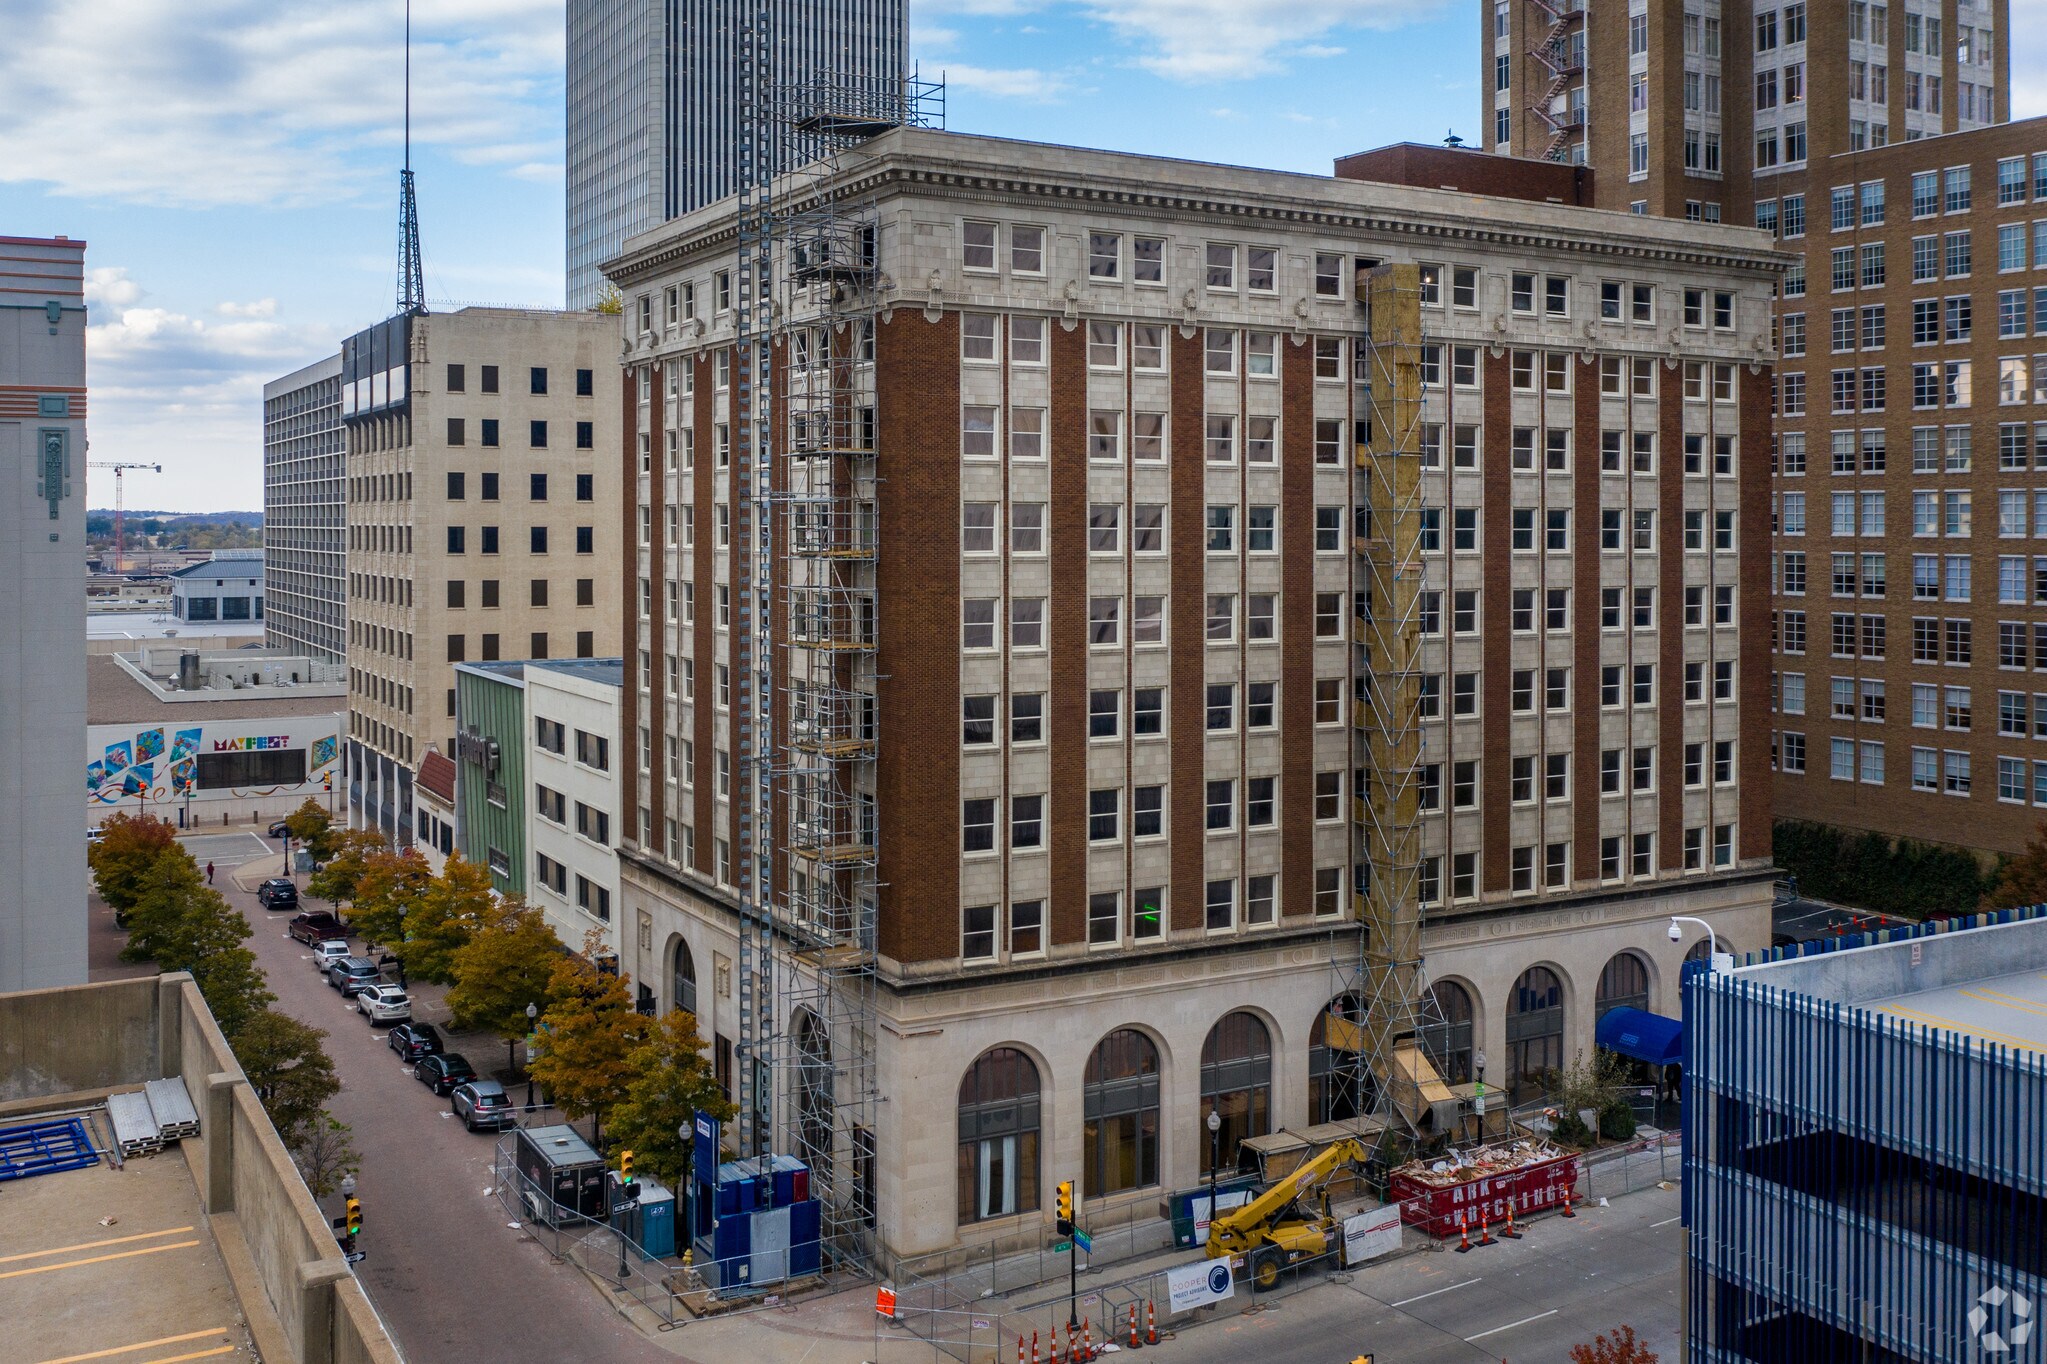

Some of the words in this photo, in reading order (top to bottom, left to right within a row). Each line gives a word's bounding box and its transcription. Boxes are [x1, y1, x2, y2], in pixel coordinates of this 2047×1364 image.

[214, 735, 290, 751] MAYFEST
[1453, 1179, 1490, 1204] ARK
[1289, 1251, 1299, 1261] CAT
[1172, 1276, 1207, 1291] COOPER
[1173, 1290, 1189, 1300] PROJECT
